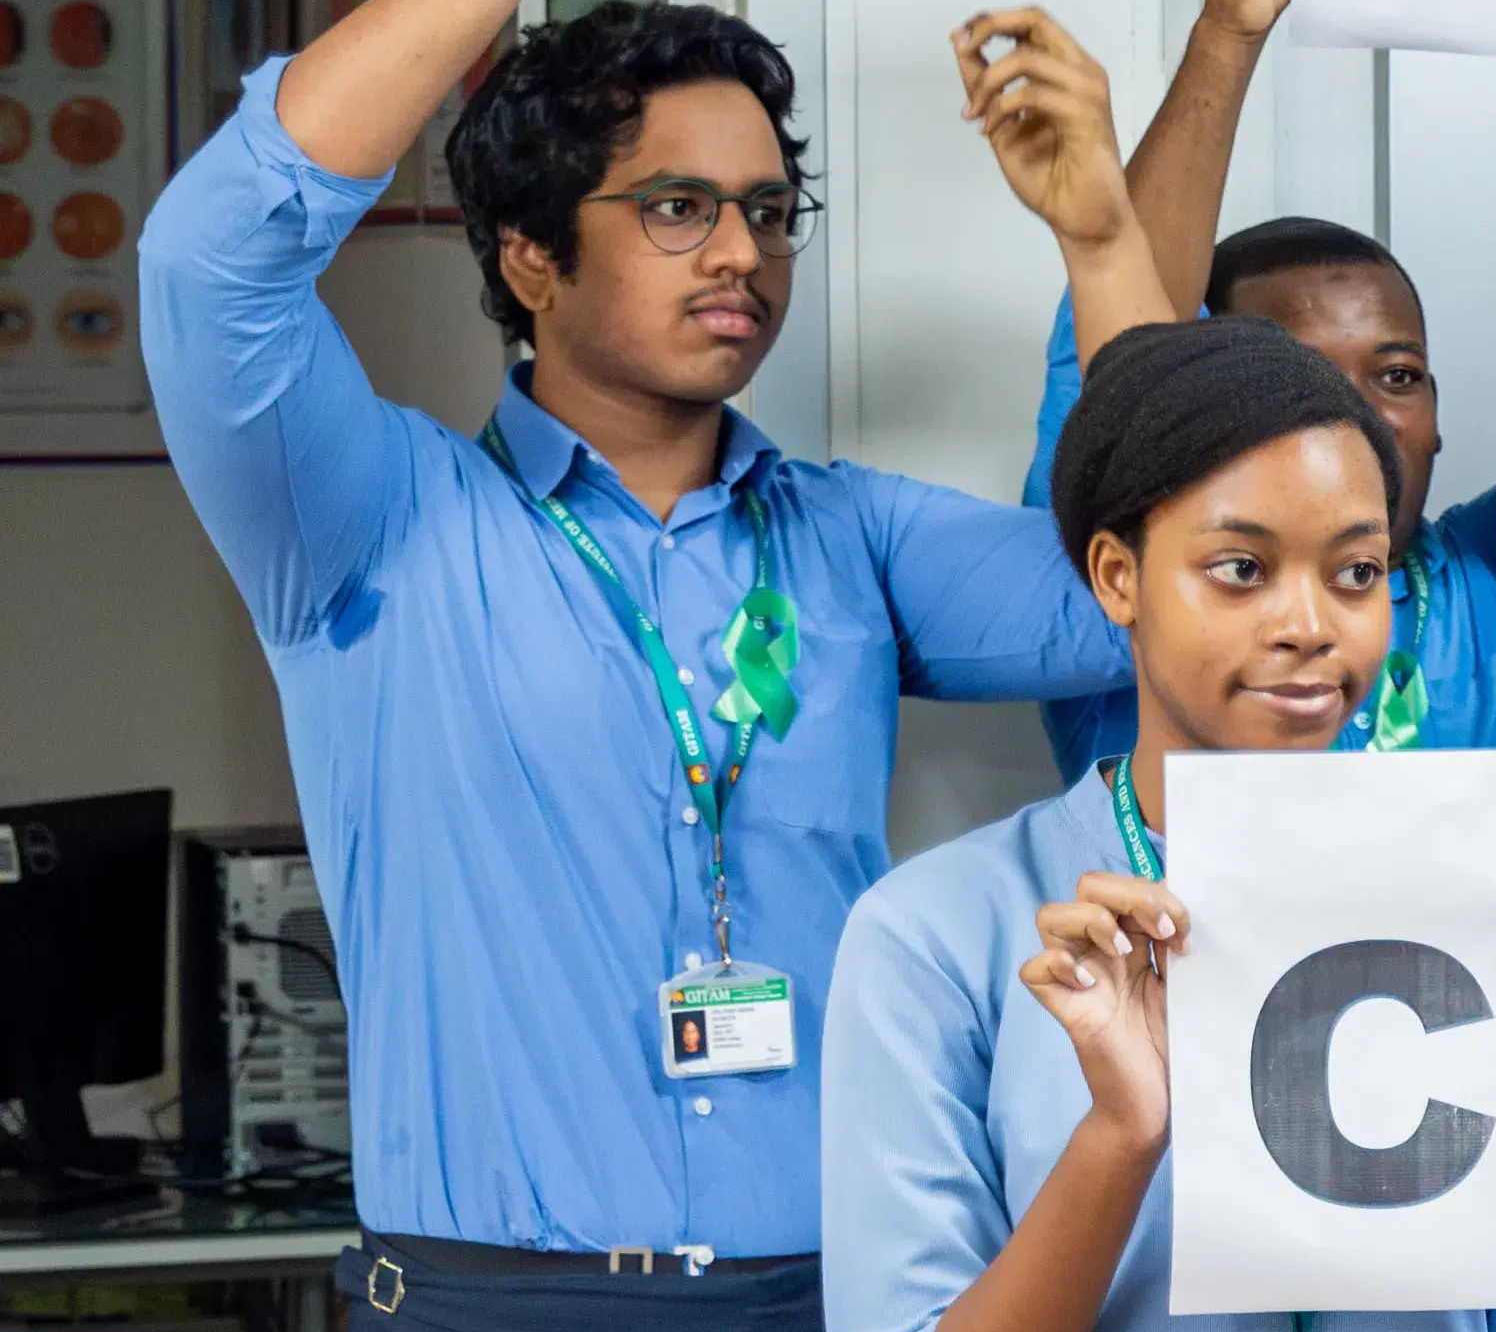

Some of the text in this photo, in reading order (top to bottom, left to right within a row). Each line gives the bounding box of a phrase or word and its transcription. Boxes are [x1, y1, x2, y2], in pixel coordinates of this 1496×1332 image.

[676, 709, 700, 757] GITAM
[738, 721, 752, 757] GITA
[1118, 784, 1131, 812] AND
[684, 986, 731, 1005] GITAM
[1250, 940, 1496, 1210] C
